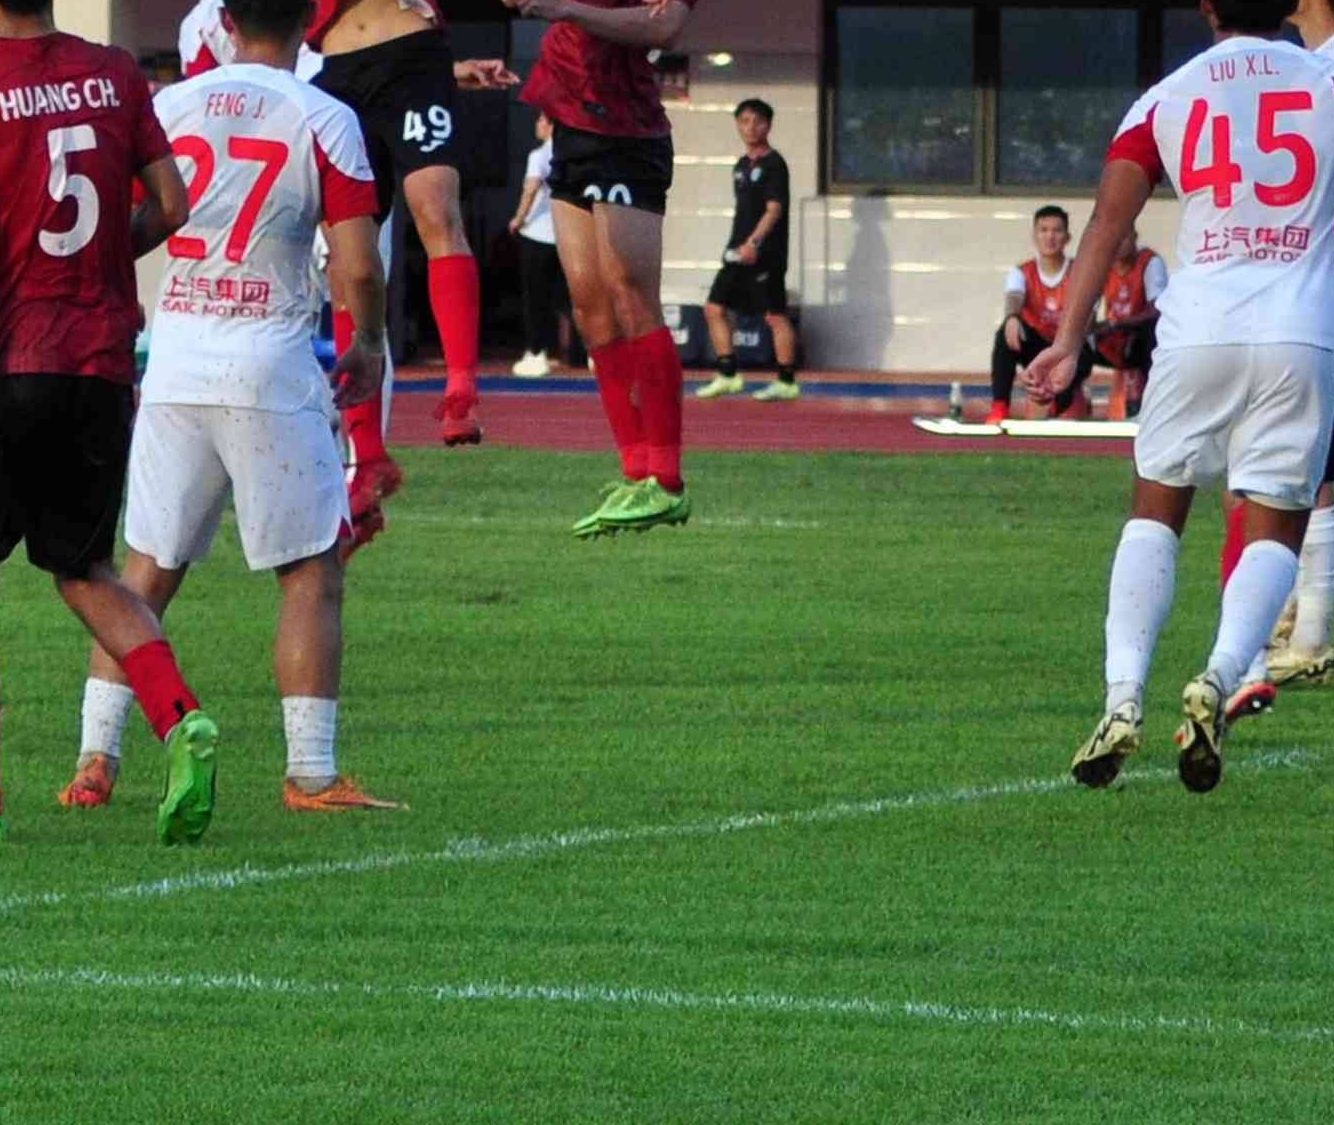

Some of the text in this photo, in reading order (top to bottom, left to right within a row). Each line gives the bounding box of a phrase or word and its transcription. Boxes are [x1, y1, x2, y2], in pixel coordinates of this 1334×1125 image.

[1210, 54, 1281, 82] LIU X.L.
[84, 78, 121, 109] CH.
[204, 92, 266, 119] FENG J.
[402, 104, 452, 142] 49
[1179, 91, 1317, 209] 45
[38, 123, 101, 257] 5
[167, 134, 290, 264] 27
[1195, 225, 1310, 253] 上汽集团
[164, 275, 271, 305] 上汽集团
[162, 300, 268, 319] SAIC MOTOR
